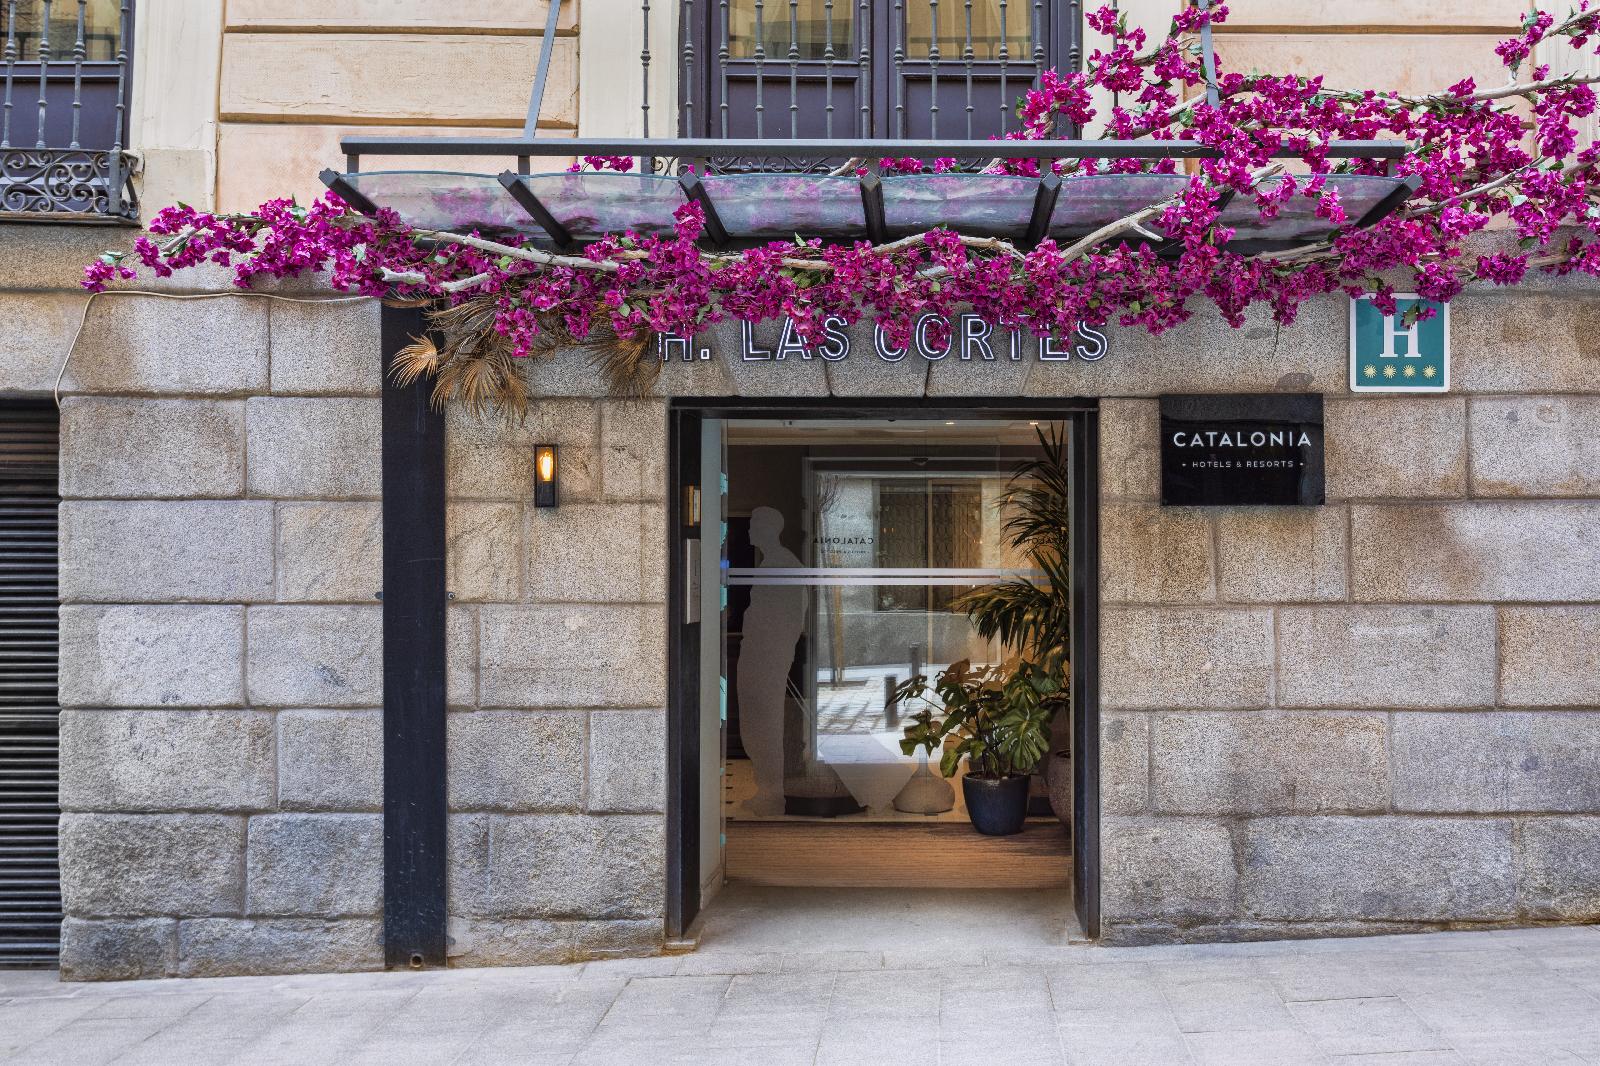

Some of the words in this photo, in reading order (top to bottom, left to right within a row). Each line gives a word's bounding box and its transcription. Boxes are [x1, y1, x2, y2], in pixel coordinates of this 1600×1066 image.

[742, 314, 849, 361] LAS
[1379, 312, 1422, 358] H
[1173, 431, 1312, 447] CATALONIA
[1246, 460, 1294, 468] RESORTS
